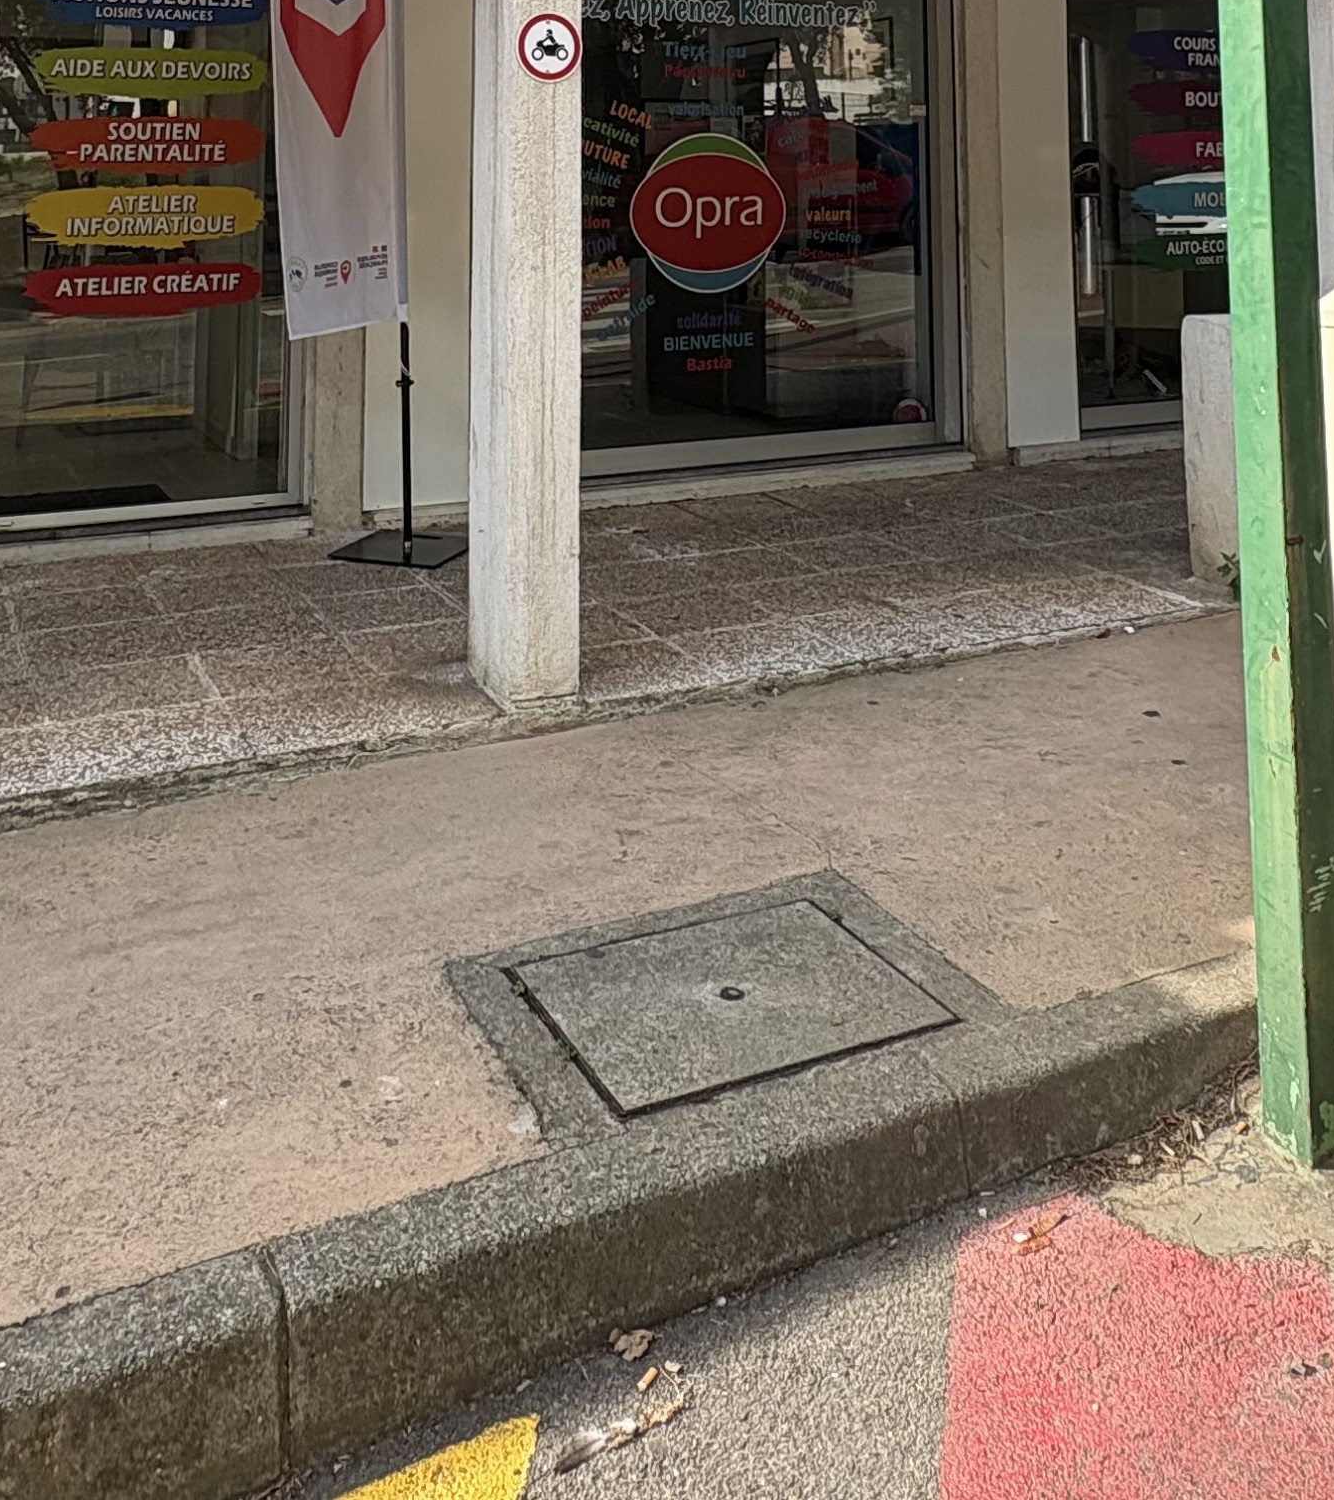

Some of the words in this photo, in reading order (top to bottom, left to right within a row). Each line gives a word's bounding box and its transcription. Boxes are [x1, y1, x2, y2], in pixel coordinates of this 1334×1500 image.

[94, 5, 144, 20] LOISIRS
[146, 7, 214, 22] VACANCES
[1173, 36, 1216, 51] COURS
[50, 58, 105, 79] AIDE
[108, 59, 156, 80] AUX
[160, 60, 253, 81] DEVOIRS
[609, 99, 652, 129] LOCAL
[106, 121, 201, 142] SOUTIEN
[78, 138, 228, 164] PARENTALITÉ
[106, 193, 197, 215] ATELIER
[654, 186, 764, 240] Opra
[805, 206, 852, 222] valeurs
[66, 214, 236, 237] INFORMATIQUE
[55, 276, 149, 300] ATELIER
[152, 270, 242, 295] CRÉATIF
[764, 298, 818, 336] partage
[663, 332, 754, 353] BIENVENUE
[686, 356, 733, 372] Bastia
